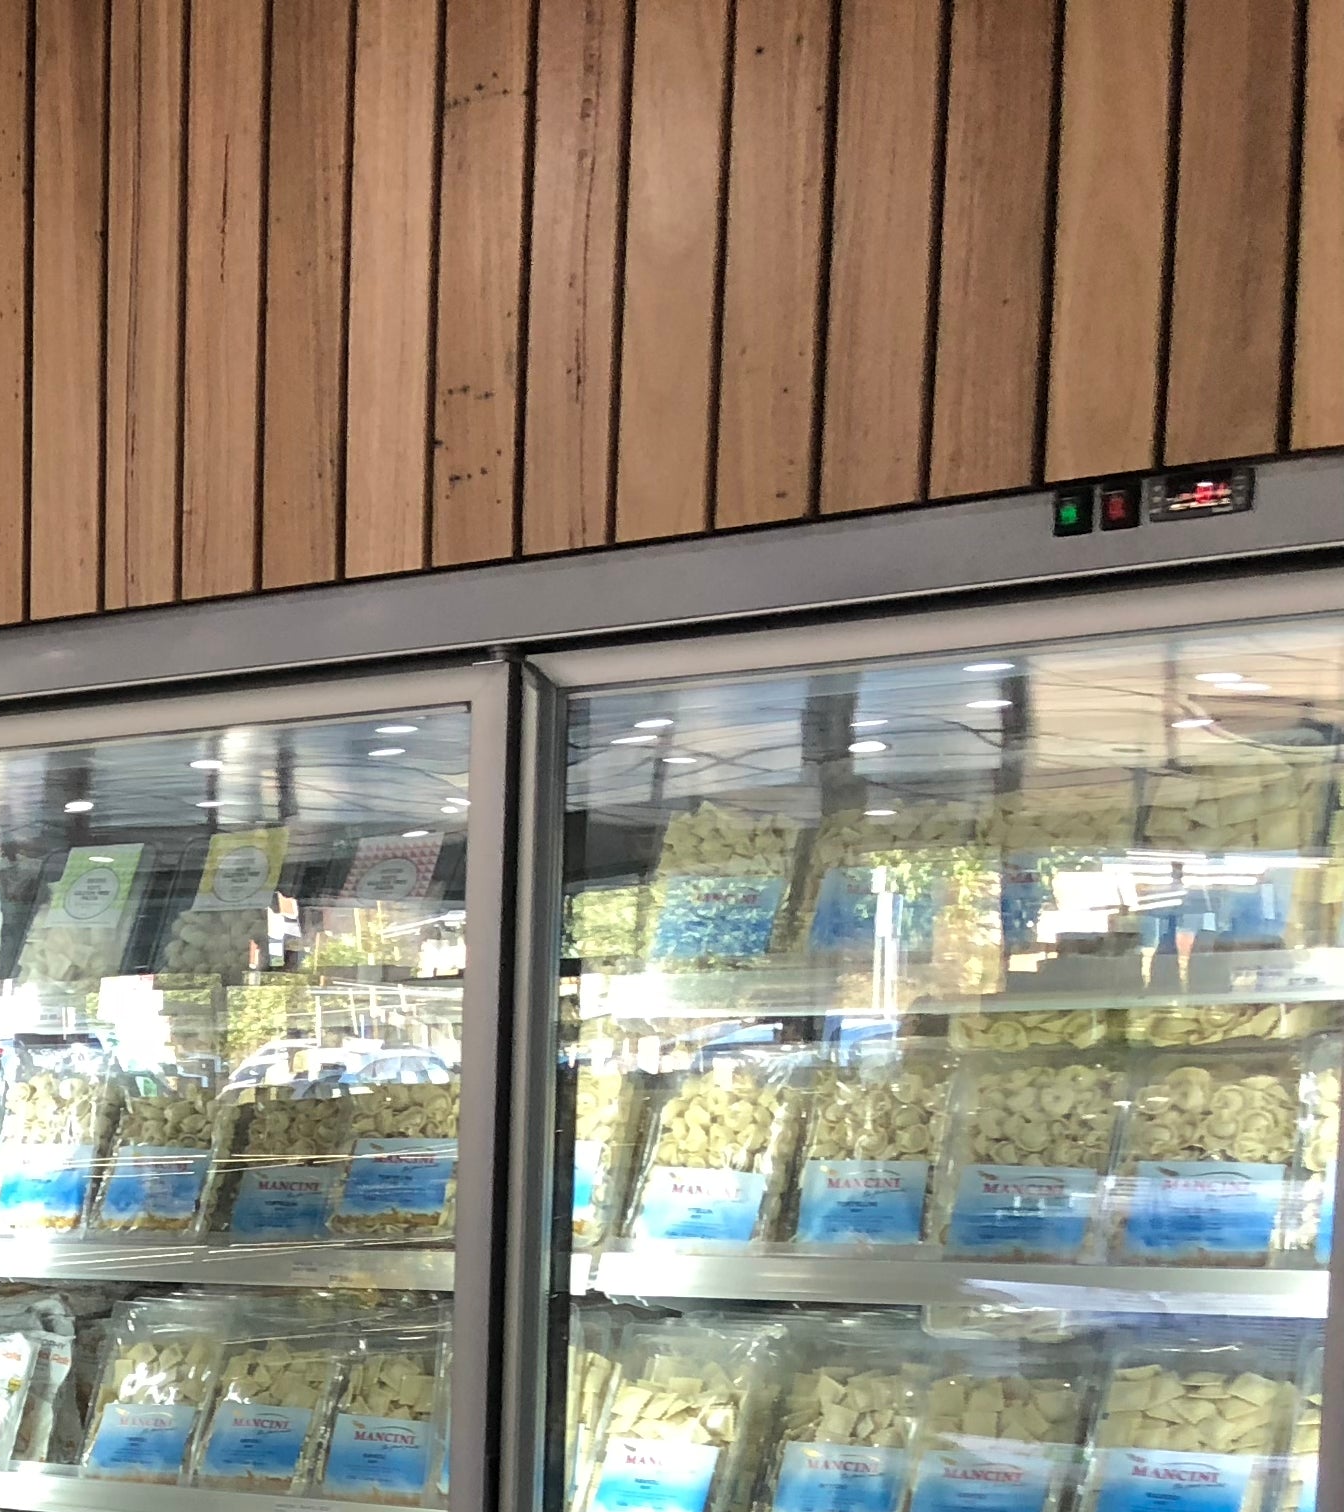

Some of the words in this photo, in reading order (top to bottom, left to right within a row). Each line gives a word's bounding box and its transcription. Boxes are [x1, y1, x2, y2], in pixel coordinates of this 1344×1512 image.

[259, 1181, 320, 1192] MANCINI
[827, 1178, 901, 1190] MANCINI
[983, 1182, 1064, 1195] MANCINI
[232, 1416, 290, 1429] MANCINI
[353, 1430, 416, 1445] MANCINI
[807, 1458, 878, 1473] MANCINI
[943, 1465, 1024, 1483] MANCINI
[1131, 1465, 1220, 1484] MANCINI
